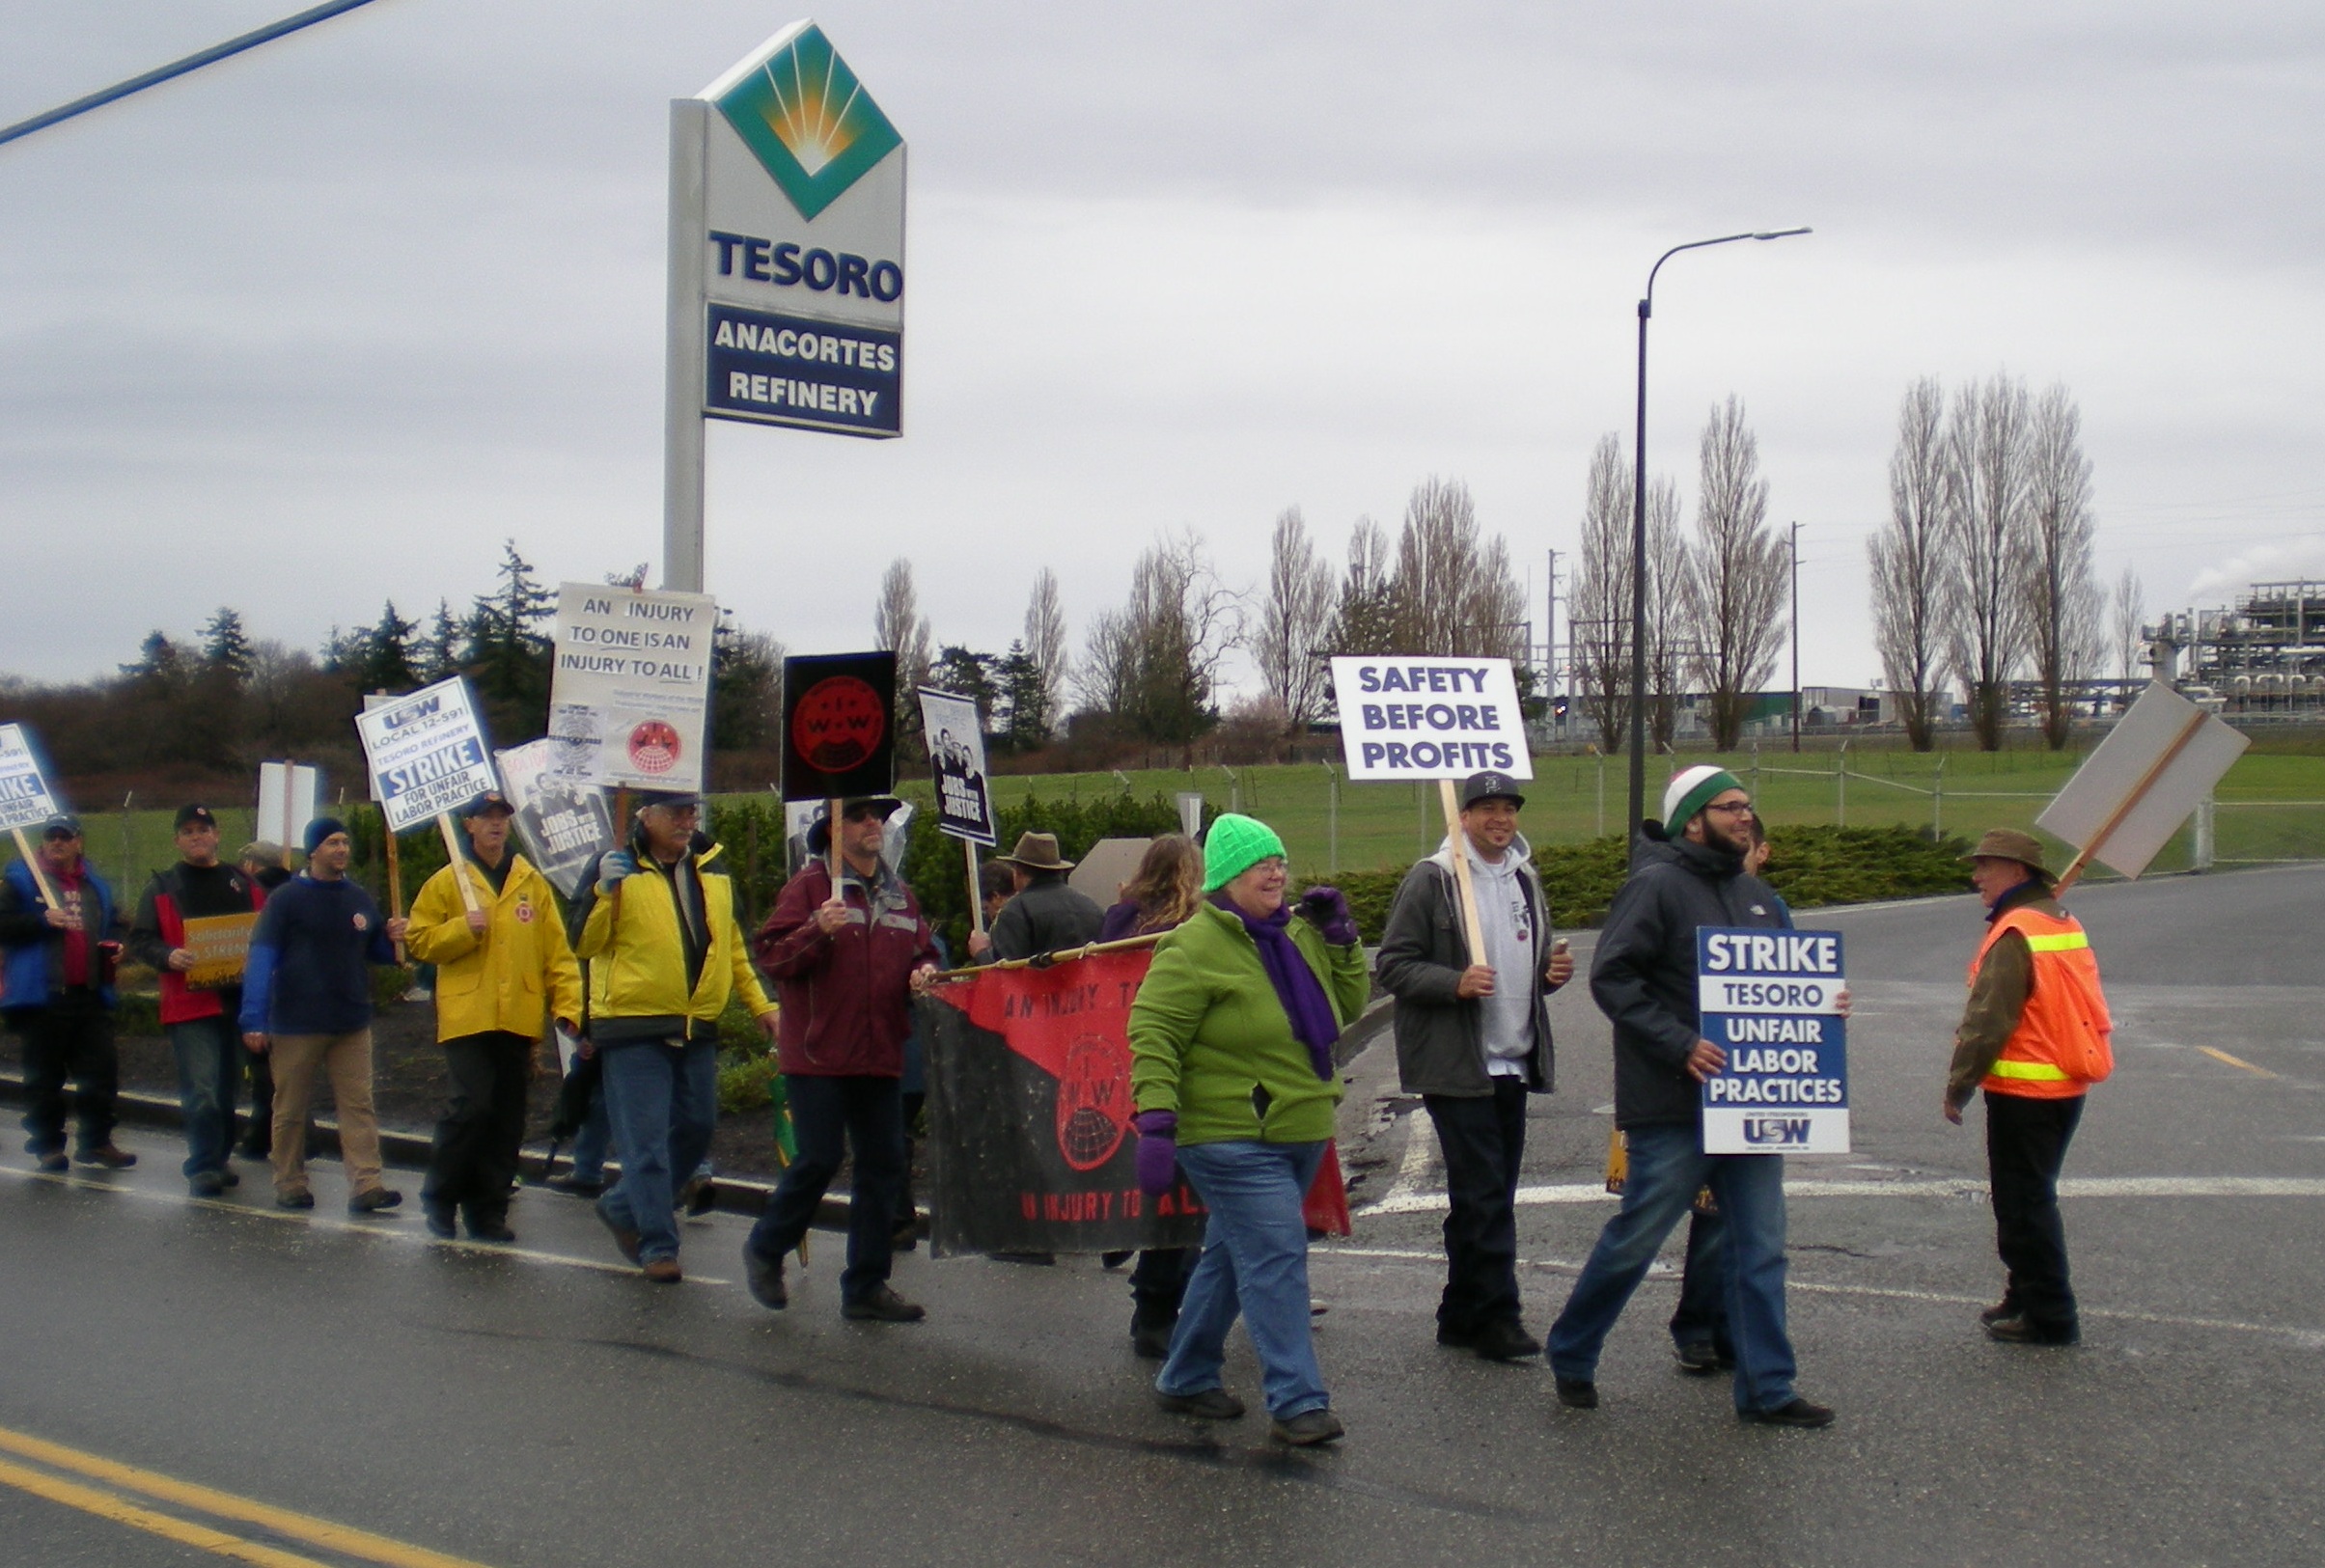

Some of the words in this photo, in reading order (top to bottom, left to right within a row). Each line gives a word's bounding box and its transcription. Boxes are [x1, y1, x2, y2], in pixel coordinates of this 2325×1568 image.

[708, 230, 903, 303] TESORO
[714, 320, 896, 372] ANACORTES
[729, 371, 878, 417] REFINERY
[583, 598, 611, 615] AN
[629, 602, 694, 622] INJURY
[570, 626, 595, 643] TO
[600, 628, 640, 646] ONE
[645, 632, 659, 647] IS
[662, 634, 690, 650] AN
[561, 653, 625, 673] INJURY
[631, 660, 656, 676] TO
[659, 663, 691, 680] ALL
[1359, 666, 1489, 693] SAFETY
[382, 696, 440, 730] USW
[1362, 703, 1501, 730] BEFORE
[373, 726, 419, 750] LOCAL
[423, 706, 464, 730] 12-591
[377, 744, 419, 766] TESORO
[421, 724, 470, 751] REFINERY
[1362, 741, 1514, 769] PROFITS
[388, 740, 475, 794] STRIKE
[403, 786, 426, 805] FOR
[427, 771, 471, 797] UNFAIR
[942, 773, 965, 797] JOBS
[395, 799, 433, 823] LABOR
[434, 778, 488, 808] PRACTICE
[944, 795, 982, 823] JUSTICE
[540, 809, 578, 838] JOBS
[548, 821, 603, 855] JUSTICE
[1706, 933, 1838, 973] STRIKE
[1005, 993, 1033, 1019] AN
[1723, 982, 1824, 1007] TESORO
[1726, 1018, 1822, 1043] UNFAIR
[1732, 1049, 1819, 1074] LABOR
[1709, 1078, 1843, 1103] PRACTICES
[1743, 1118, 1813, 1143] USW
